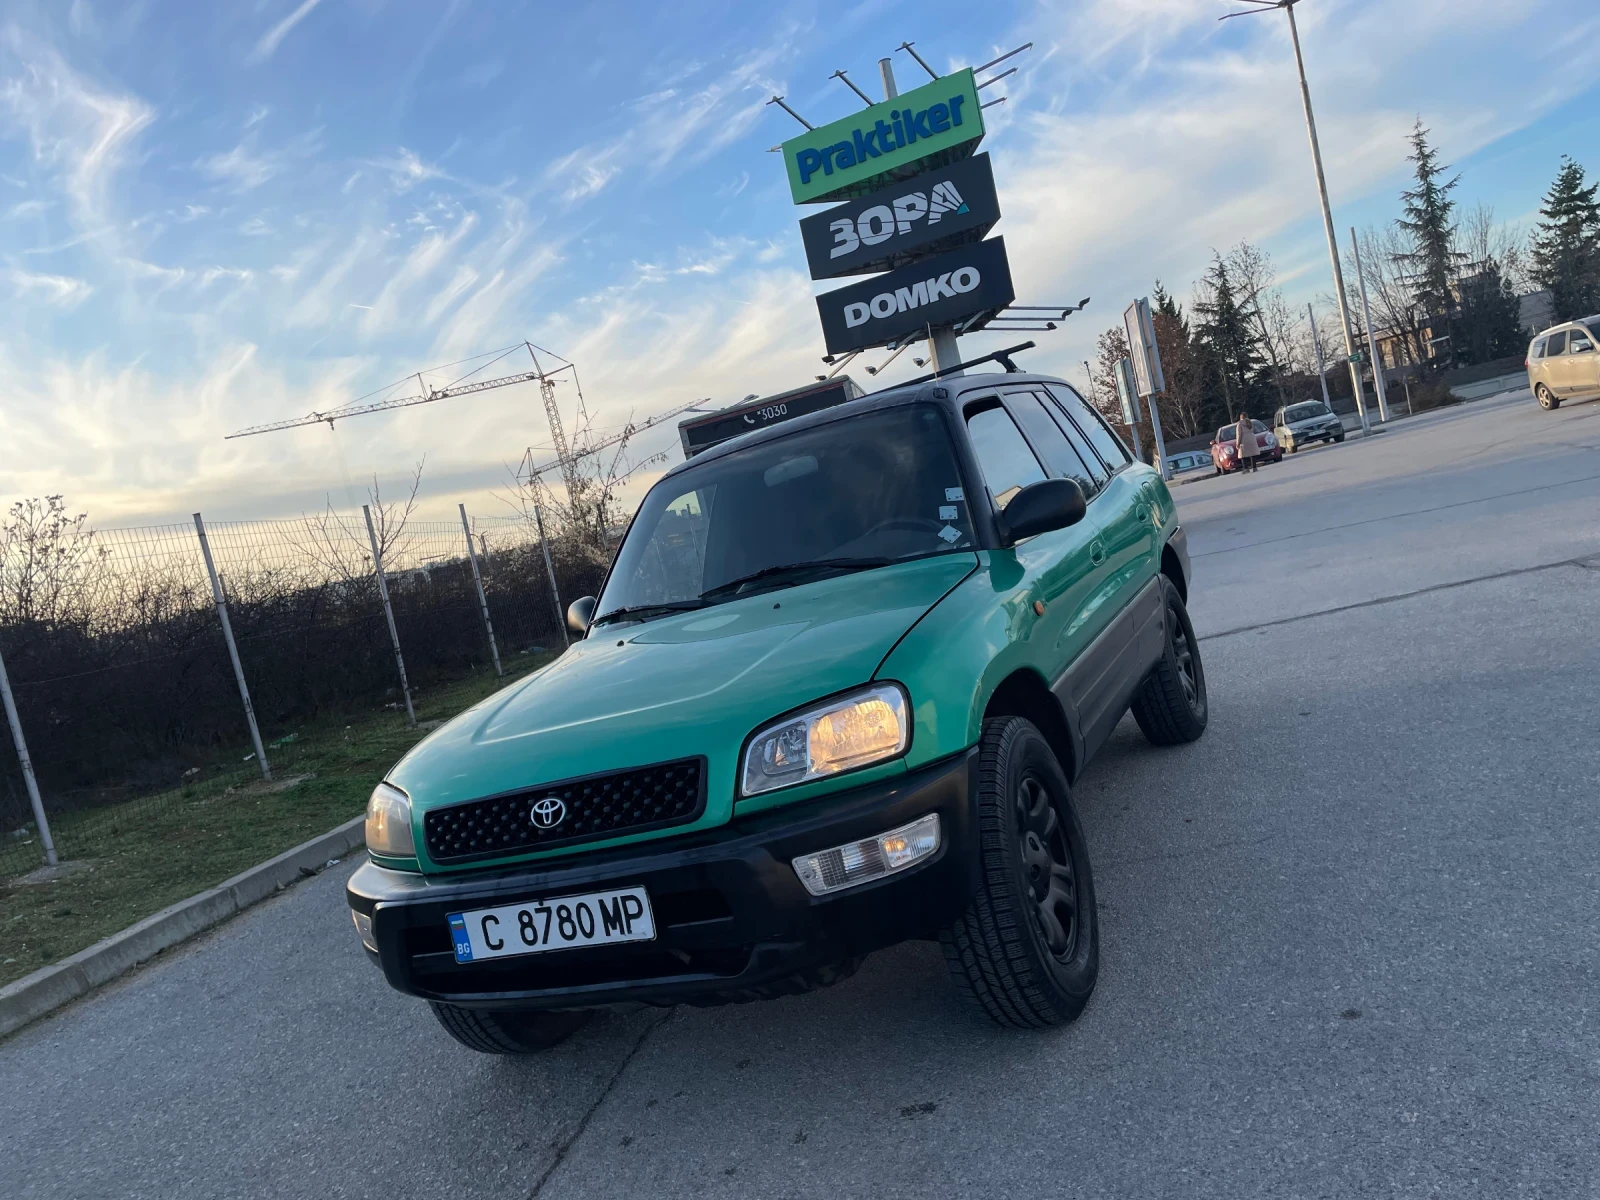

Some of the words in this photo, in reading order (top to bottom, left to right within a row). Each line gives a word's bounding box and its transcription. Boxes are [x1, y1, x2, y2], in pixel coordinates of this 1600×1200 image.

[796, 94, 965, 185] Praktiker
[829, 180, 969, 260] ЗОРА
[843, 266, 981, 329] DOMKO
[457, 942, 471, 955] BG
[480, 914, 505, 951] C
[517, 901, 596, 947] 8780
[598, 894, 644, 938] MP
